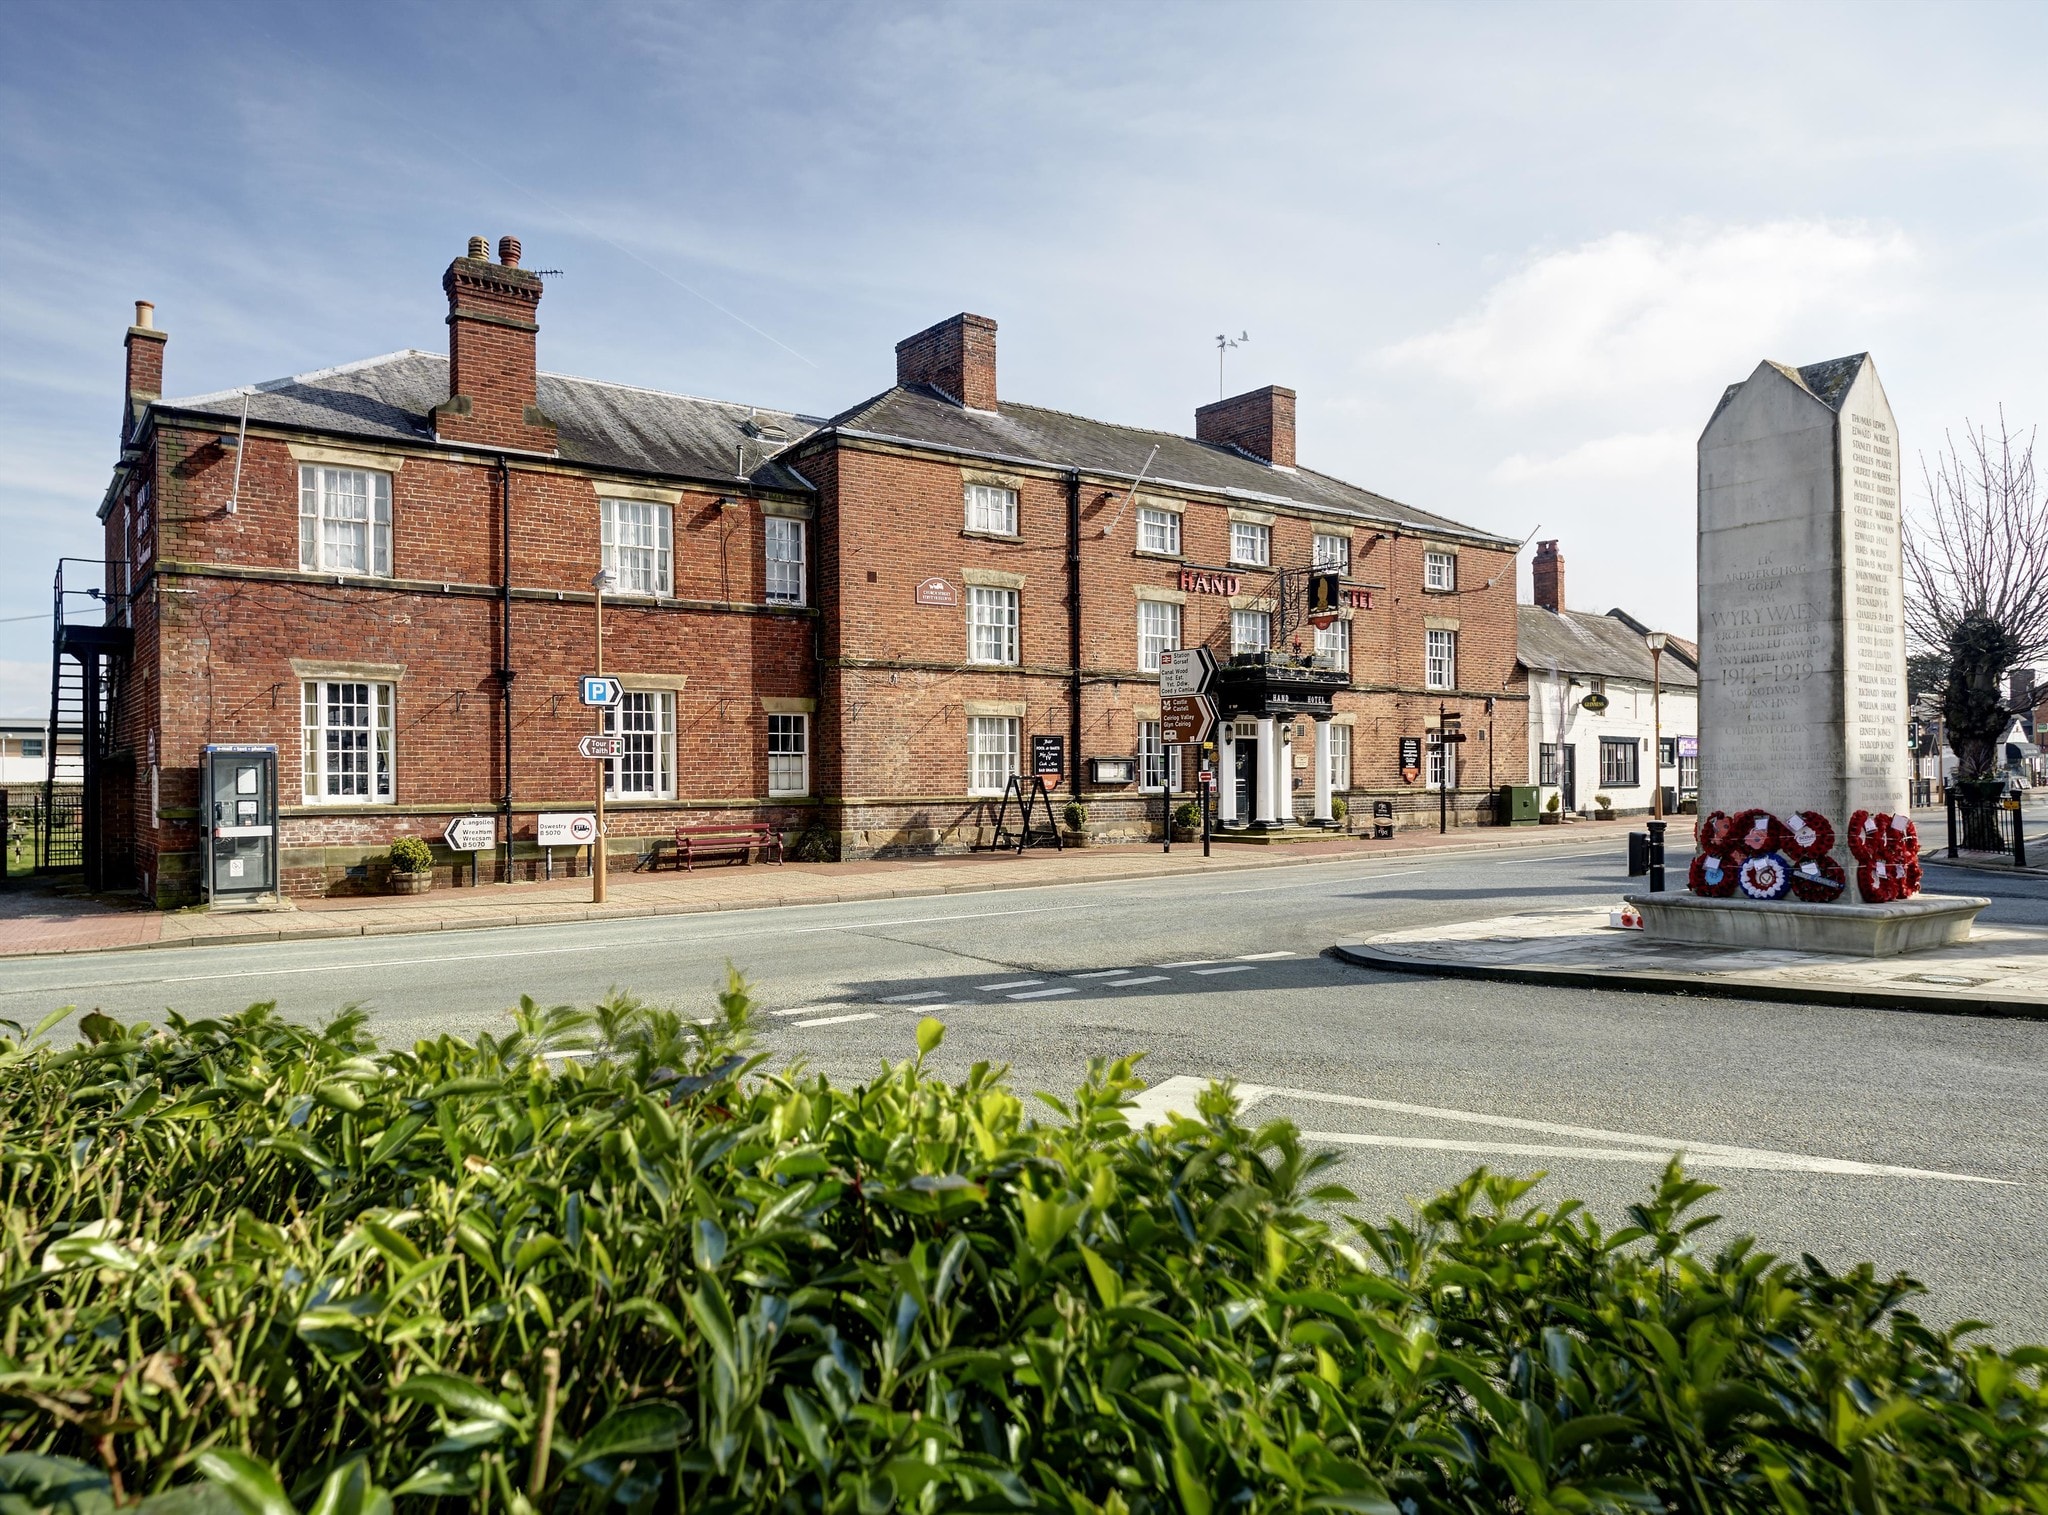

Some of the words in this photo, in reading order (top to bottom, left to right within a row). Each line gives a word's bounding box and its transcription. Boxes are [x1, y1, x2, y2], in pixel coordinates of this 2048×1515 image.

[1180, 570, 1240, 596] HAND
[592, 684, 604, 699] P
[1273, 694, 1289, 702] HAND
[1308, 696, 1325, 704] HOTEL
